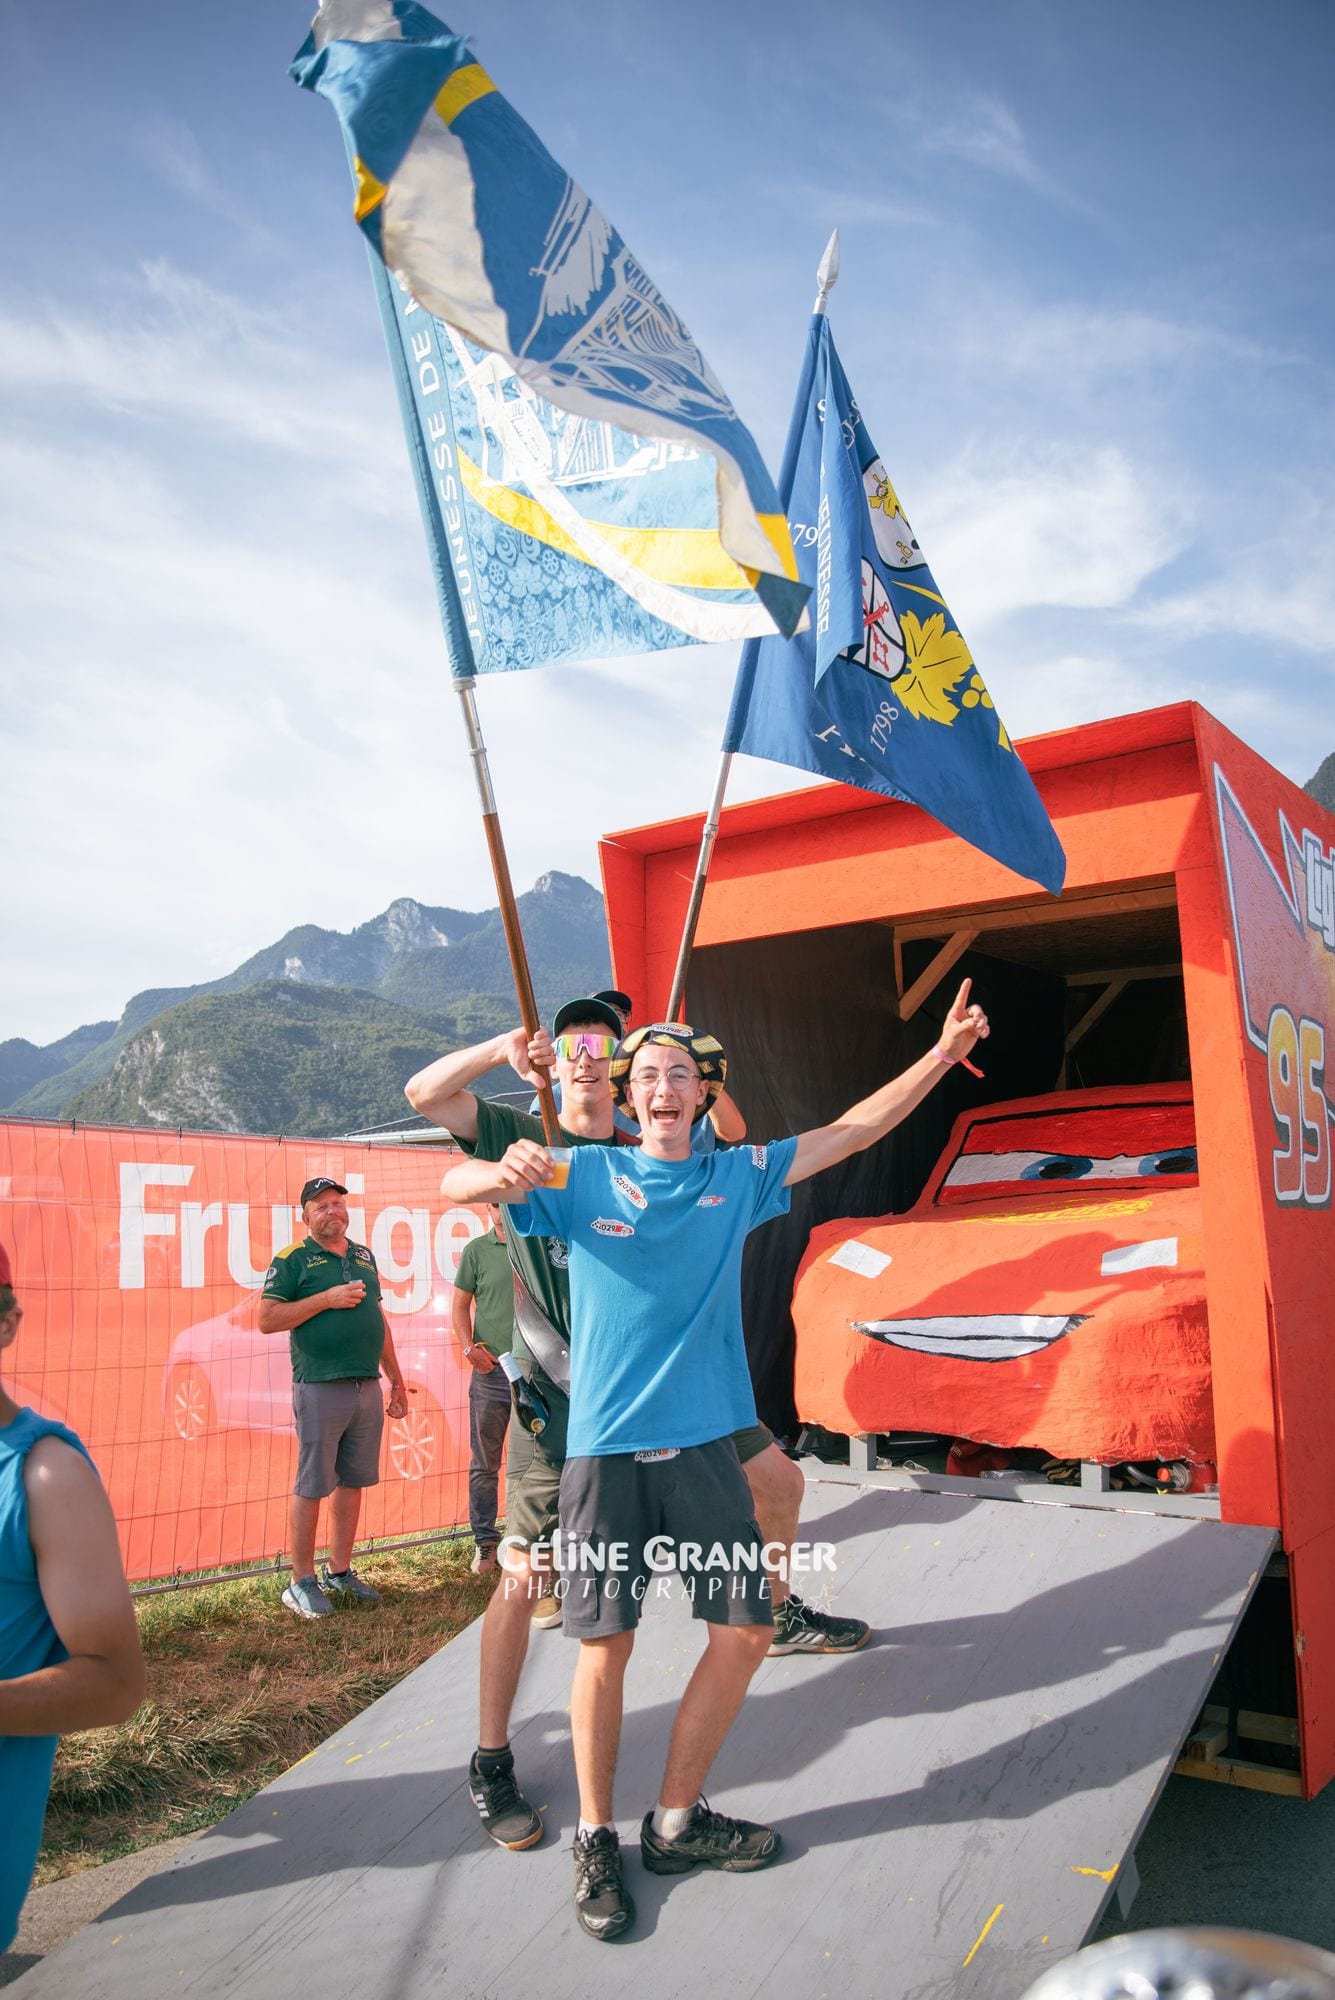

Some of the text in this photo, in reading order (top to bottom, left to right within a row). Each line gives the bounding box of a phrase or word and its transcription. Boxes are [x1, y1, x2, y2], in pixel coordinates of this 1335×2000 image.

[410, 329, 483, 646] JEUNESSE DE
[787, 521, 819, 548] 79
[870, 701, 899, 756] 1798
[1303, 829, 1335, 952] Lig
[1267, 1003, 1333, 1206] 95
[119, 1162, 497, 1314] Fruige
